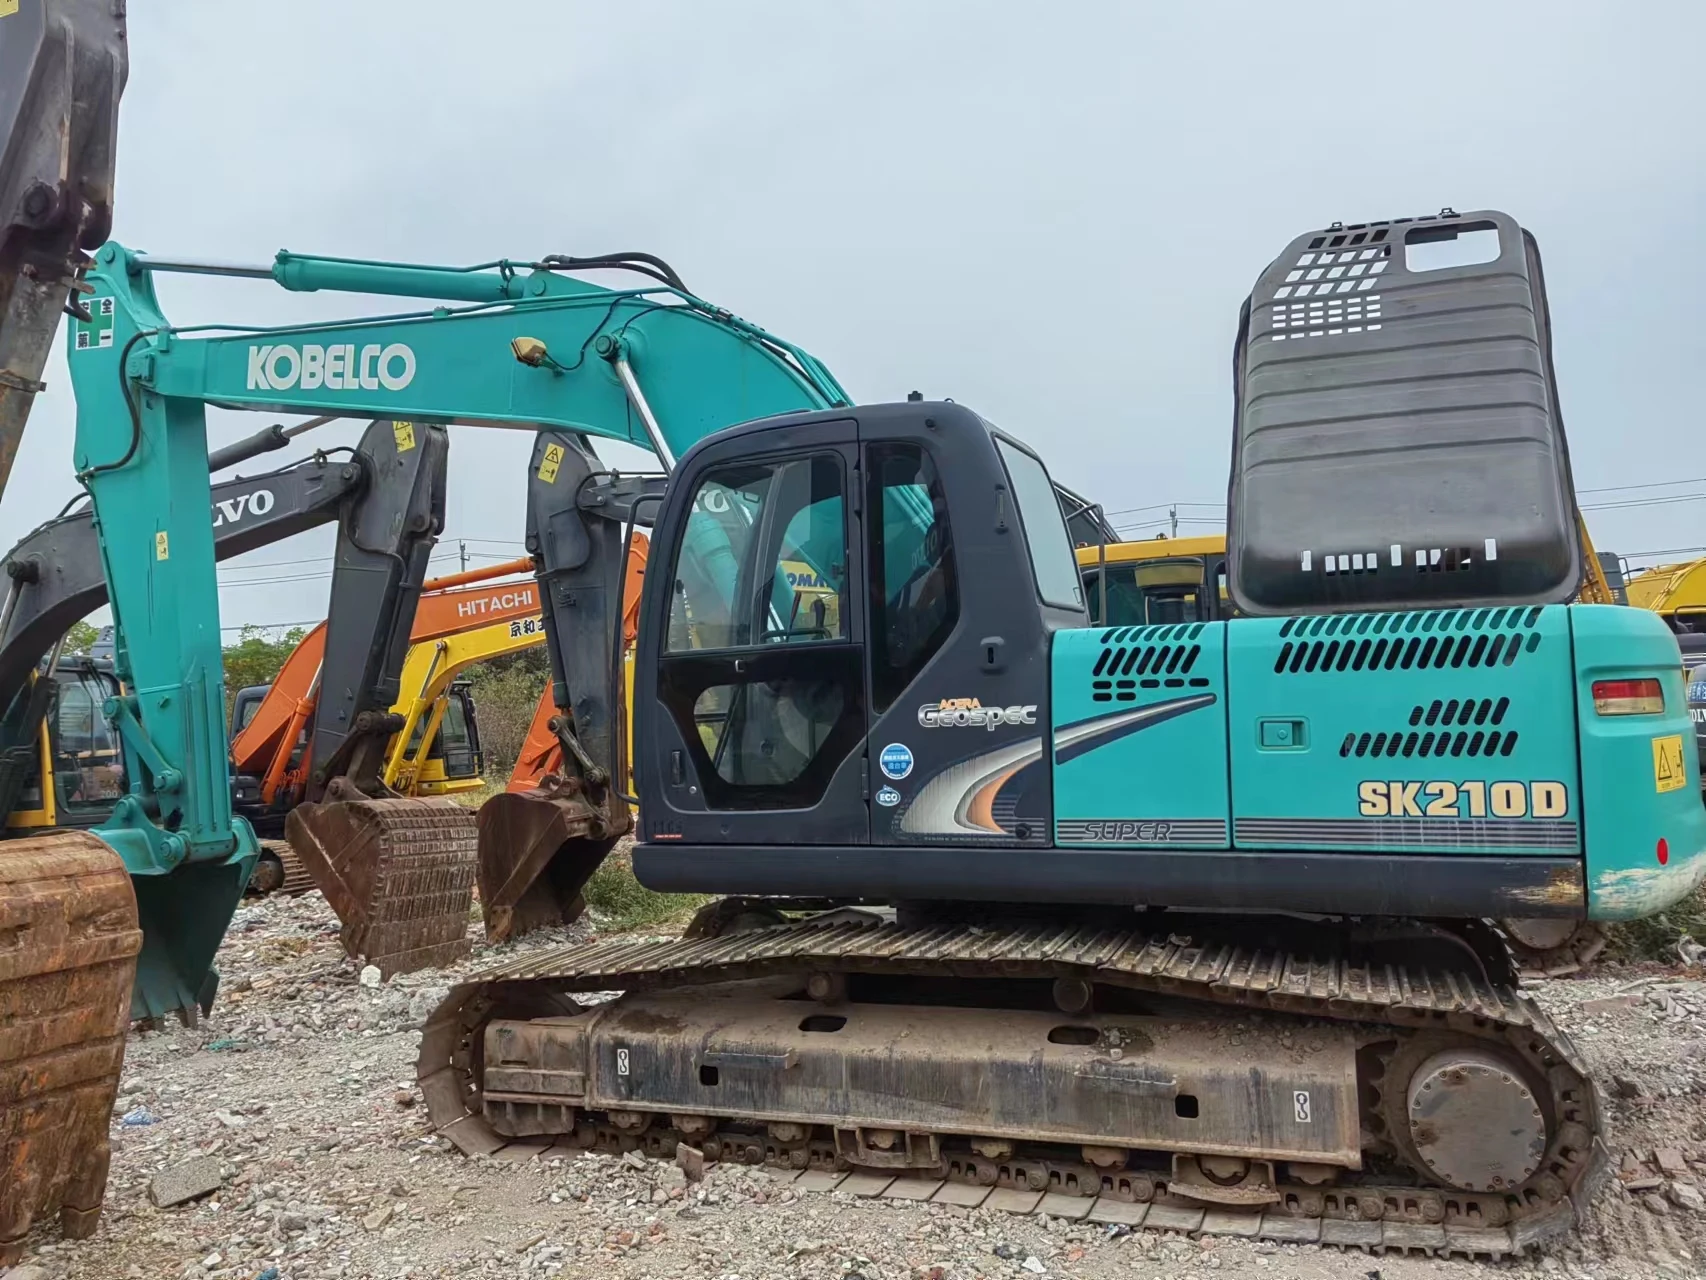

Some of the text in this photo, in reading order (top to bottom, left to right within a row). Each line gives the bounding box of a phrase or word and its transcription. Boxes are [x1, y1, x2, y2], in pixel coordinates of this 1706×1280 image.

[247, 343, 416, 391] KOBELCO
[457, 590, 533, 617] HITACHI
[939, 697, 981, 710] ACERA
[879, 793, 898, 802] ECO
[1357, 780, 1569, 819] SK210D
[1082, 822, 1173, 842] SUPER
